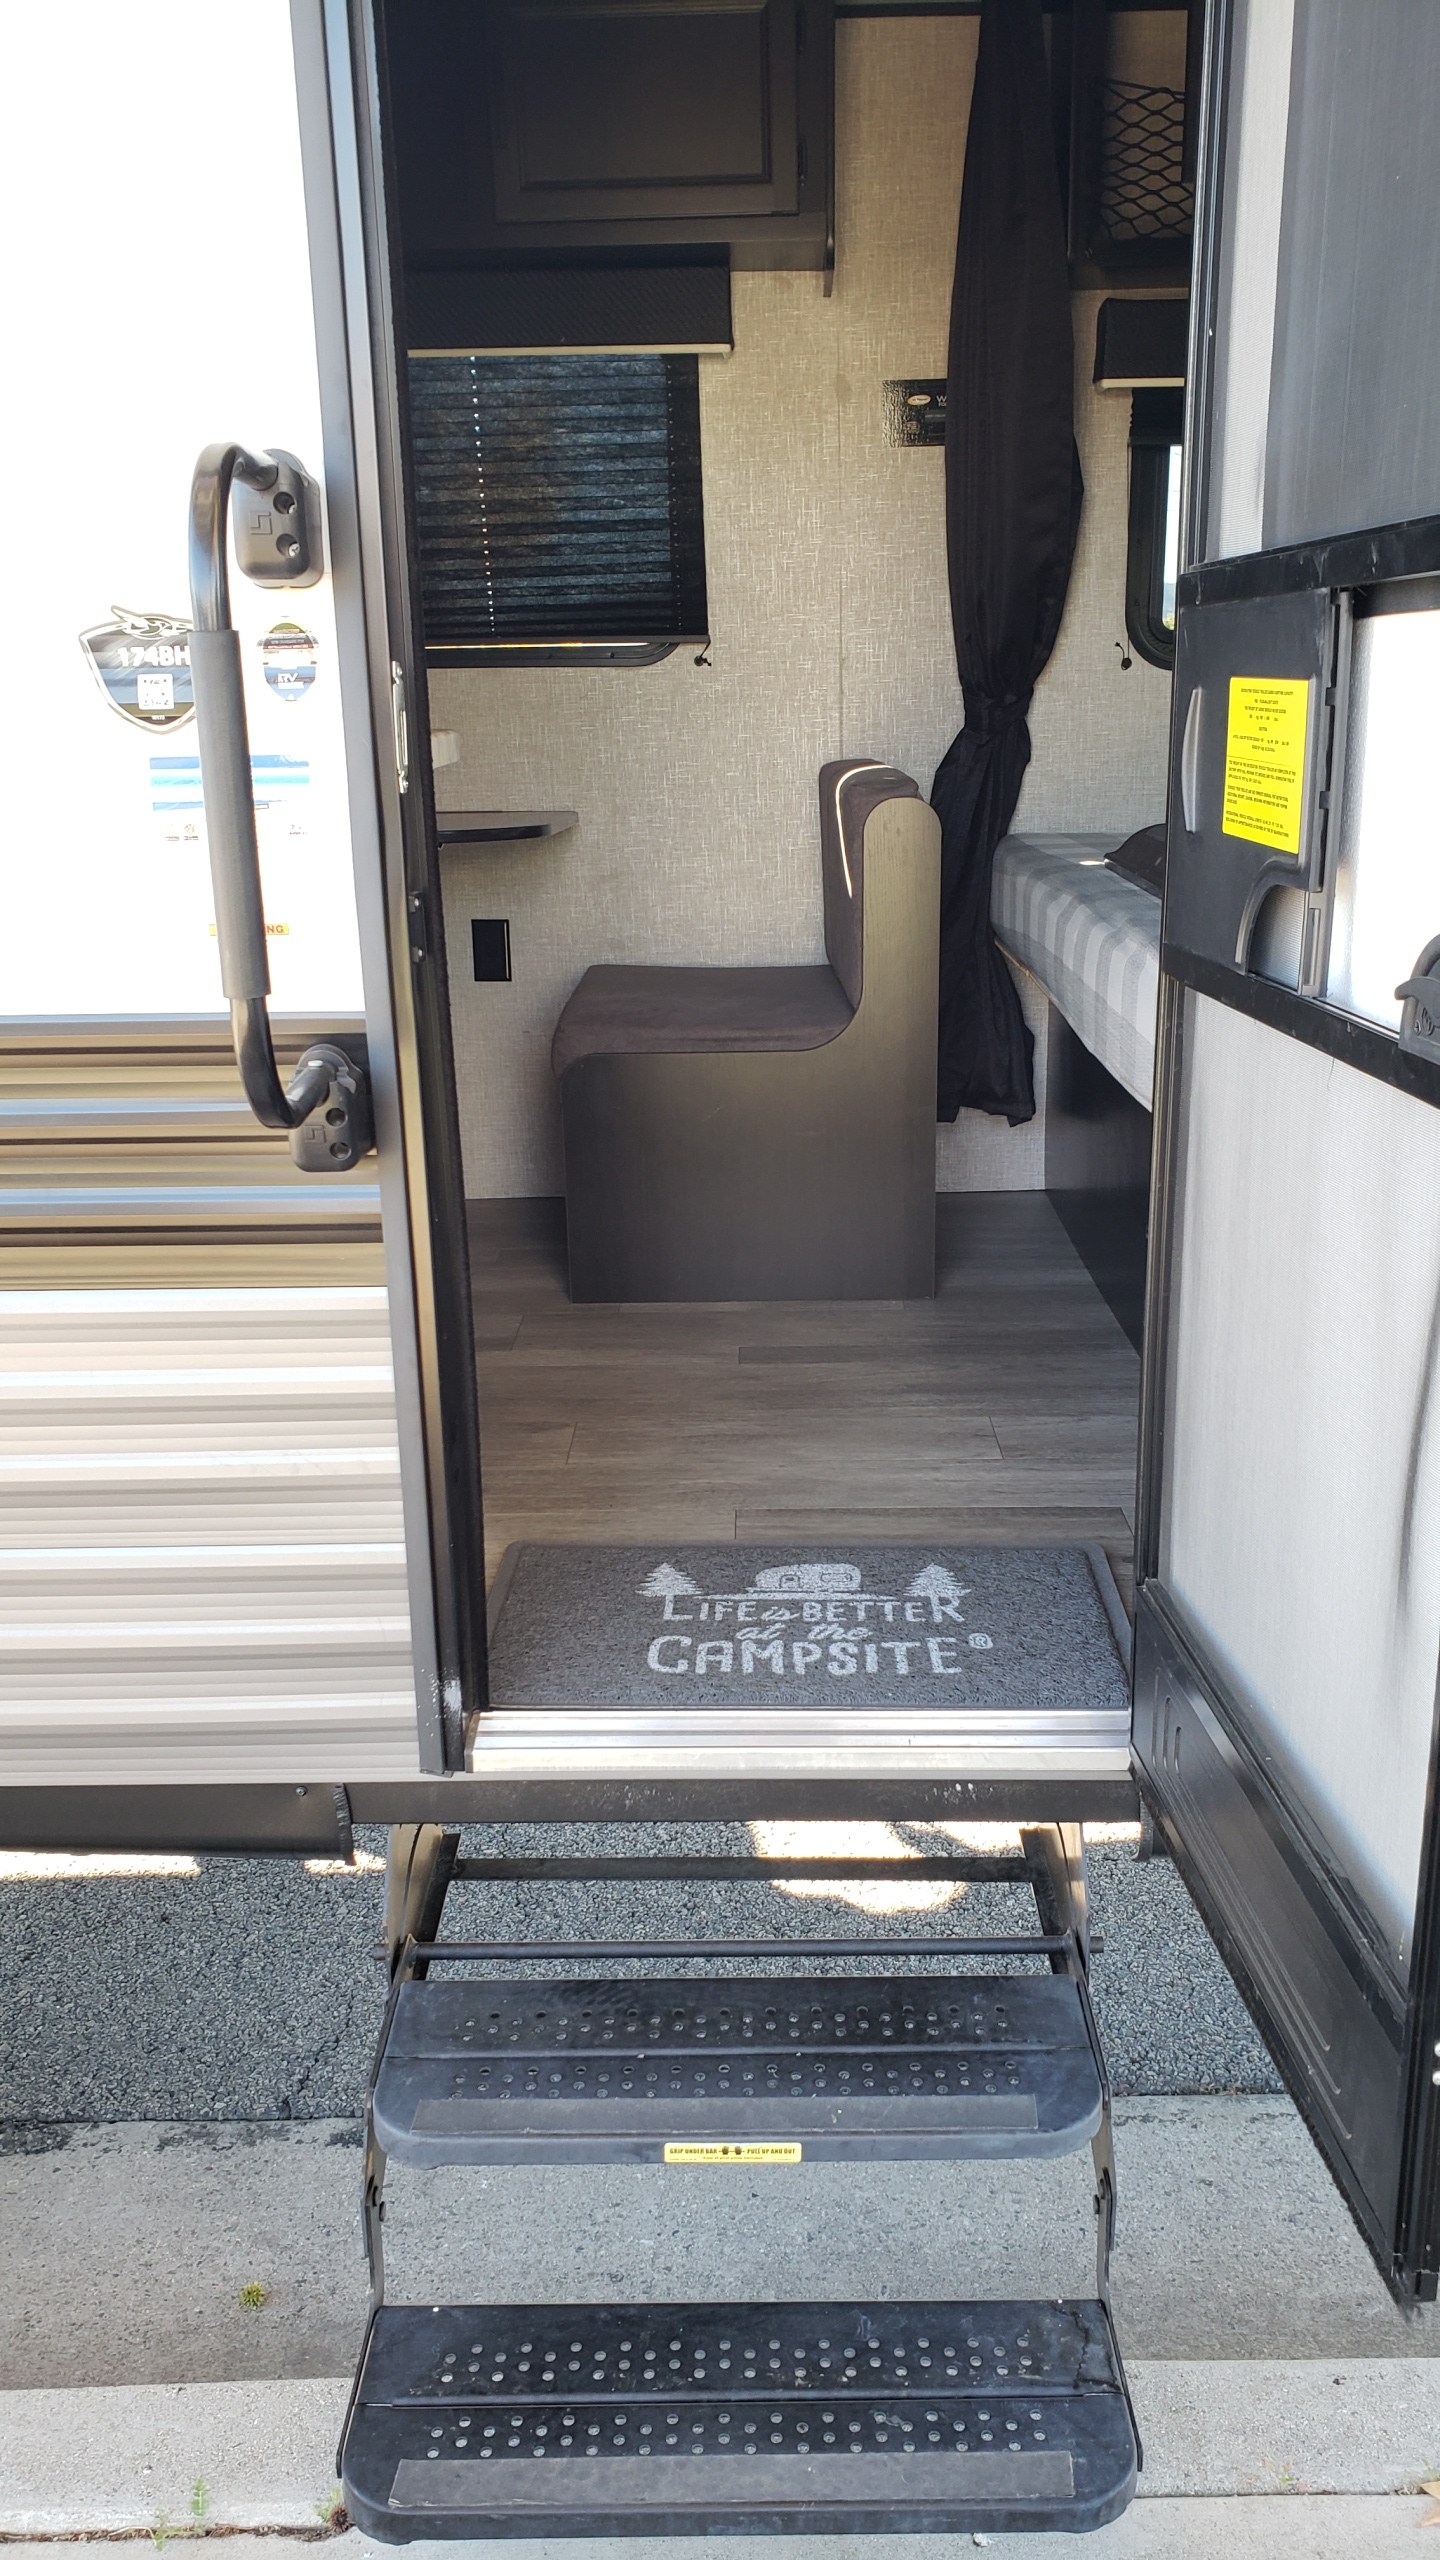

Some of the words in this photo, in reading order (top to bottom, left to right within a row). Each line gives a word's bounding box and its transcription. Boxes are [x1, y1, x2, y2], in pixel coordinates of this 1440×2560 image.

[663, 1598, 757, 1622] LIFE
[760, 1606, 800, 1622] is
[802, 1597, 965, 1623] BETTER
[735, 1622, 787, 1641] at
[806, 1623, 873, 1641] the
